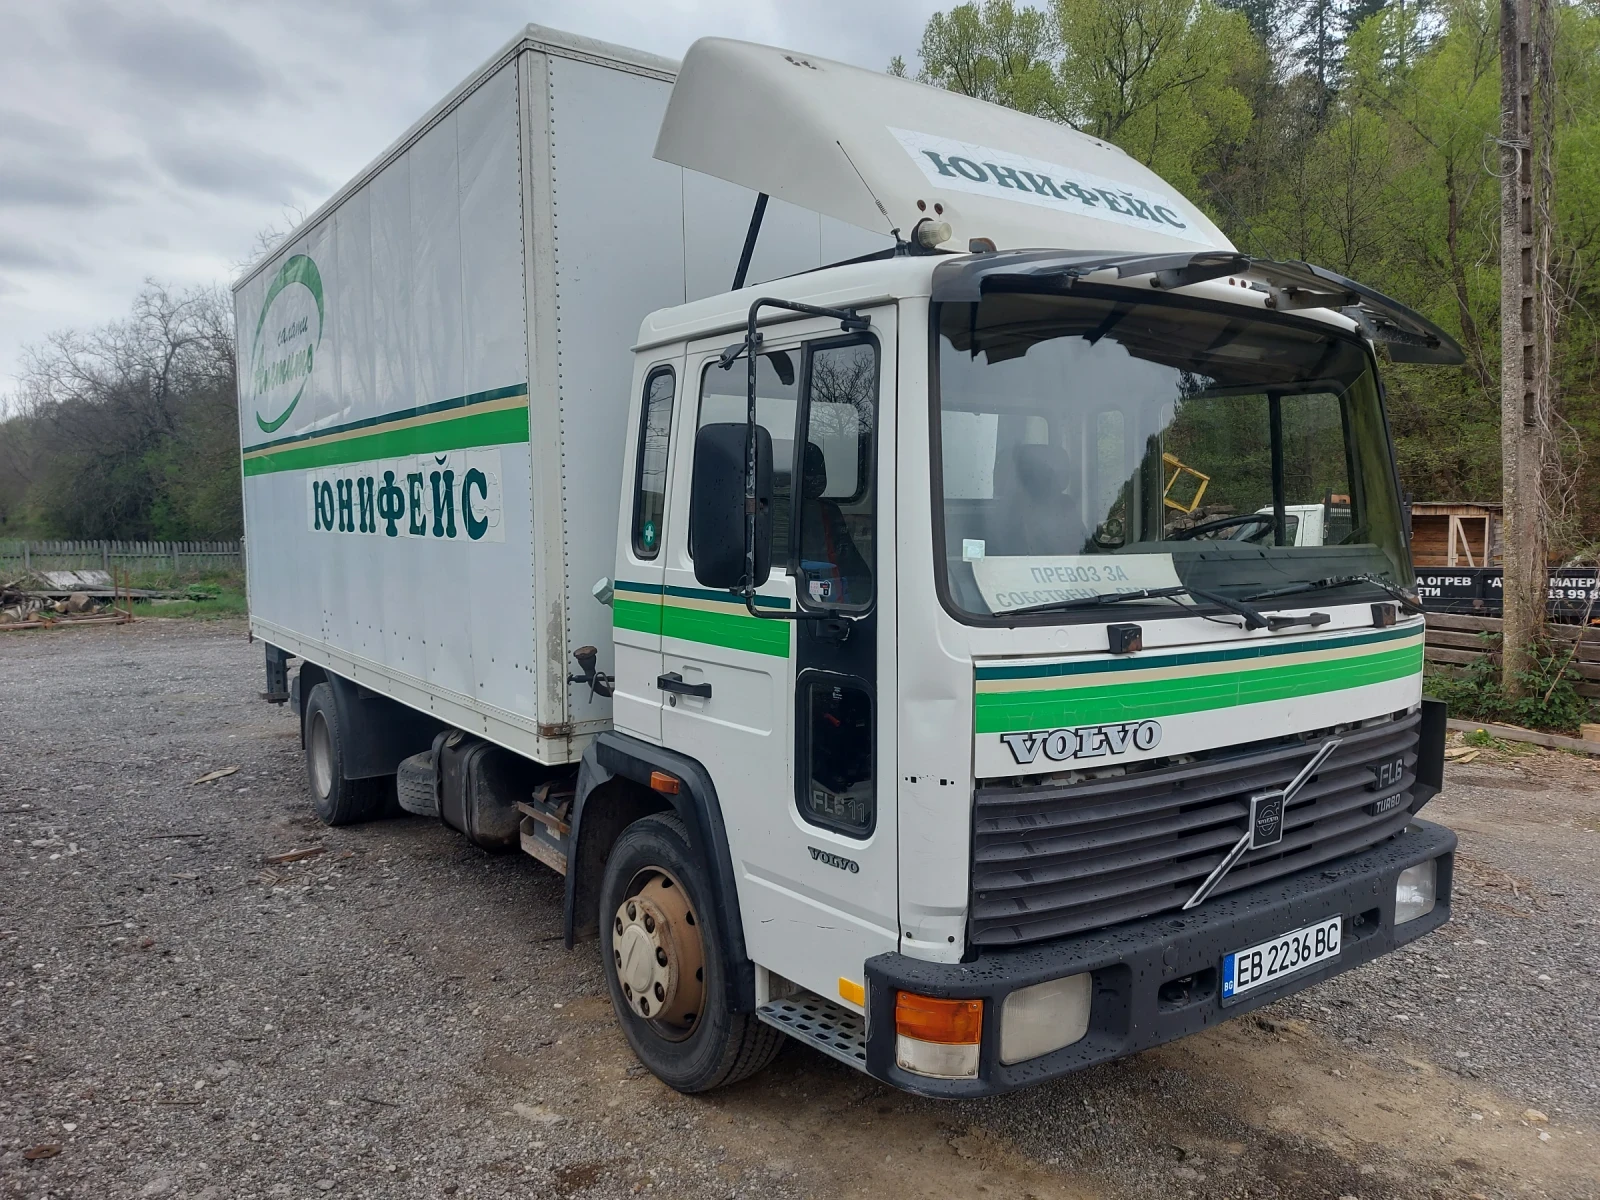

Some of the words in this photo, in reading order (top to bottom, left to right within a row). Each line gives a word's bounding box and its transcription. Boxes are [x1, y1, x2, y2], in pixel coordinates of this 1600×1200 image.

[922, 150, 1187, 229] ЮНИФЕЙС
[313, 454, 489, 541] ЮНИФЕЙС
[1029, 565, 1102, 584] ПРЕВОЗ
[1103, 565, 1129, 582] ЗА
[1416, 577, 1425, 586] А
[1427, 577, 1472, 586] ОГРЕВ
[1549, 578, 1597, 588] МАТЕР
[1417, 587, 1441, 597] ЕТИ
[1567, 589, 1586, 599] 99
[1589, 589, 1600, 600] 8
[1000, 720, 1163, 764] VOLVO
[847, 799, 865, 823] 11
[1376, 793, 1401, 814] TURBO
[1257, 816, 1279, 825] VOLVO
[807, 846, 860, 874] VOLVO
[1237, 950, 1263, 988] EB
[1267, 932, 1311, 976] 2236
[1315, 923, 1338, 958] BC
[1224, 980, 1234, 992] BG
